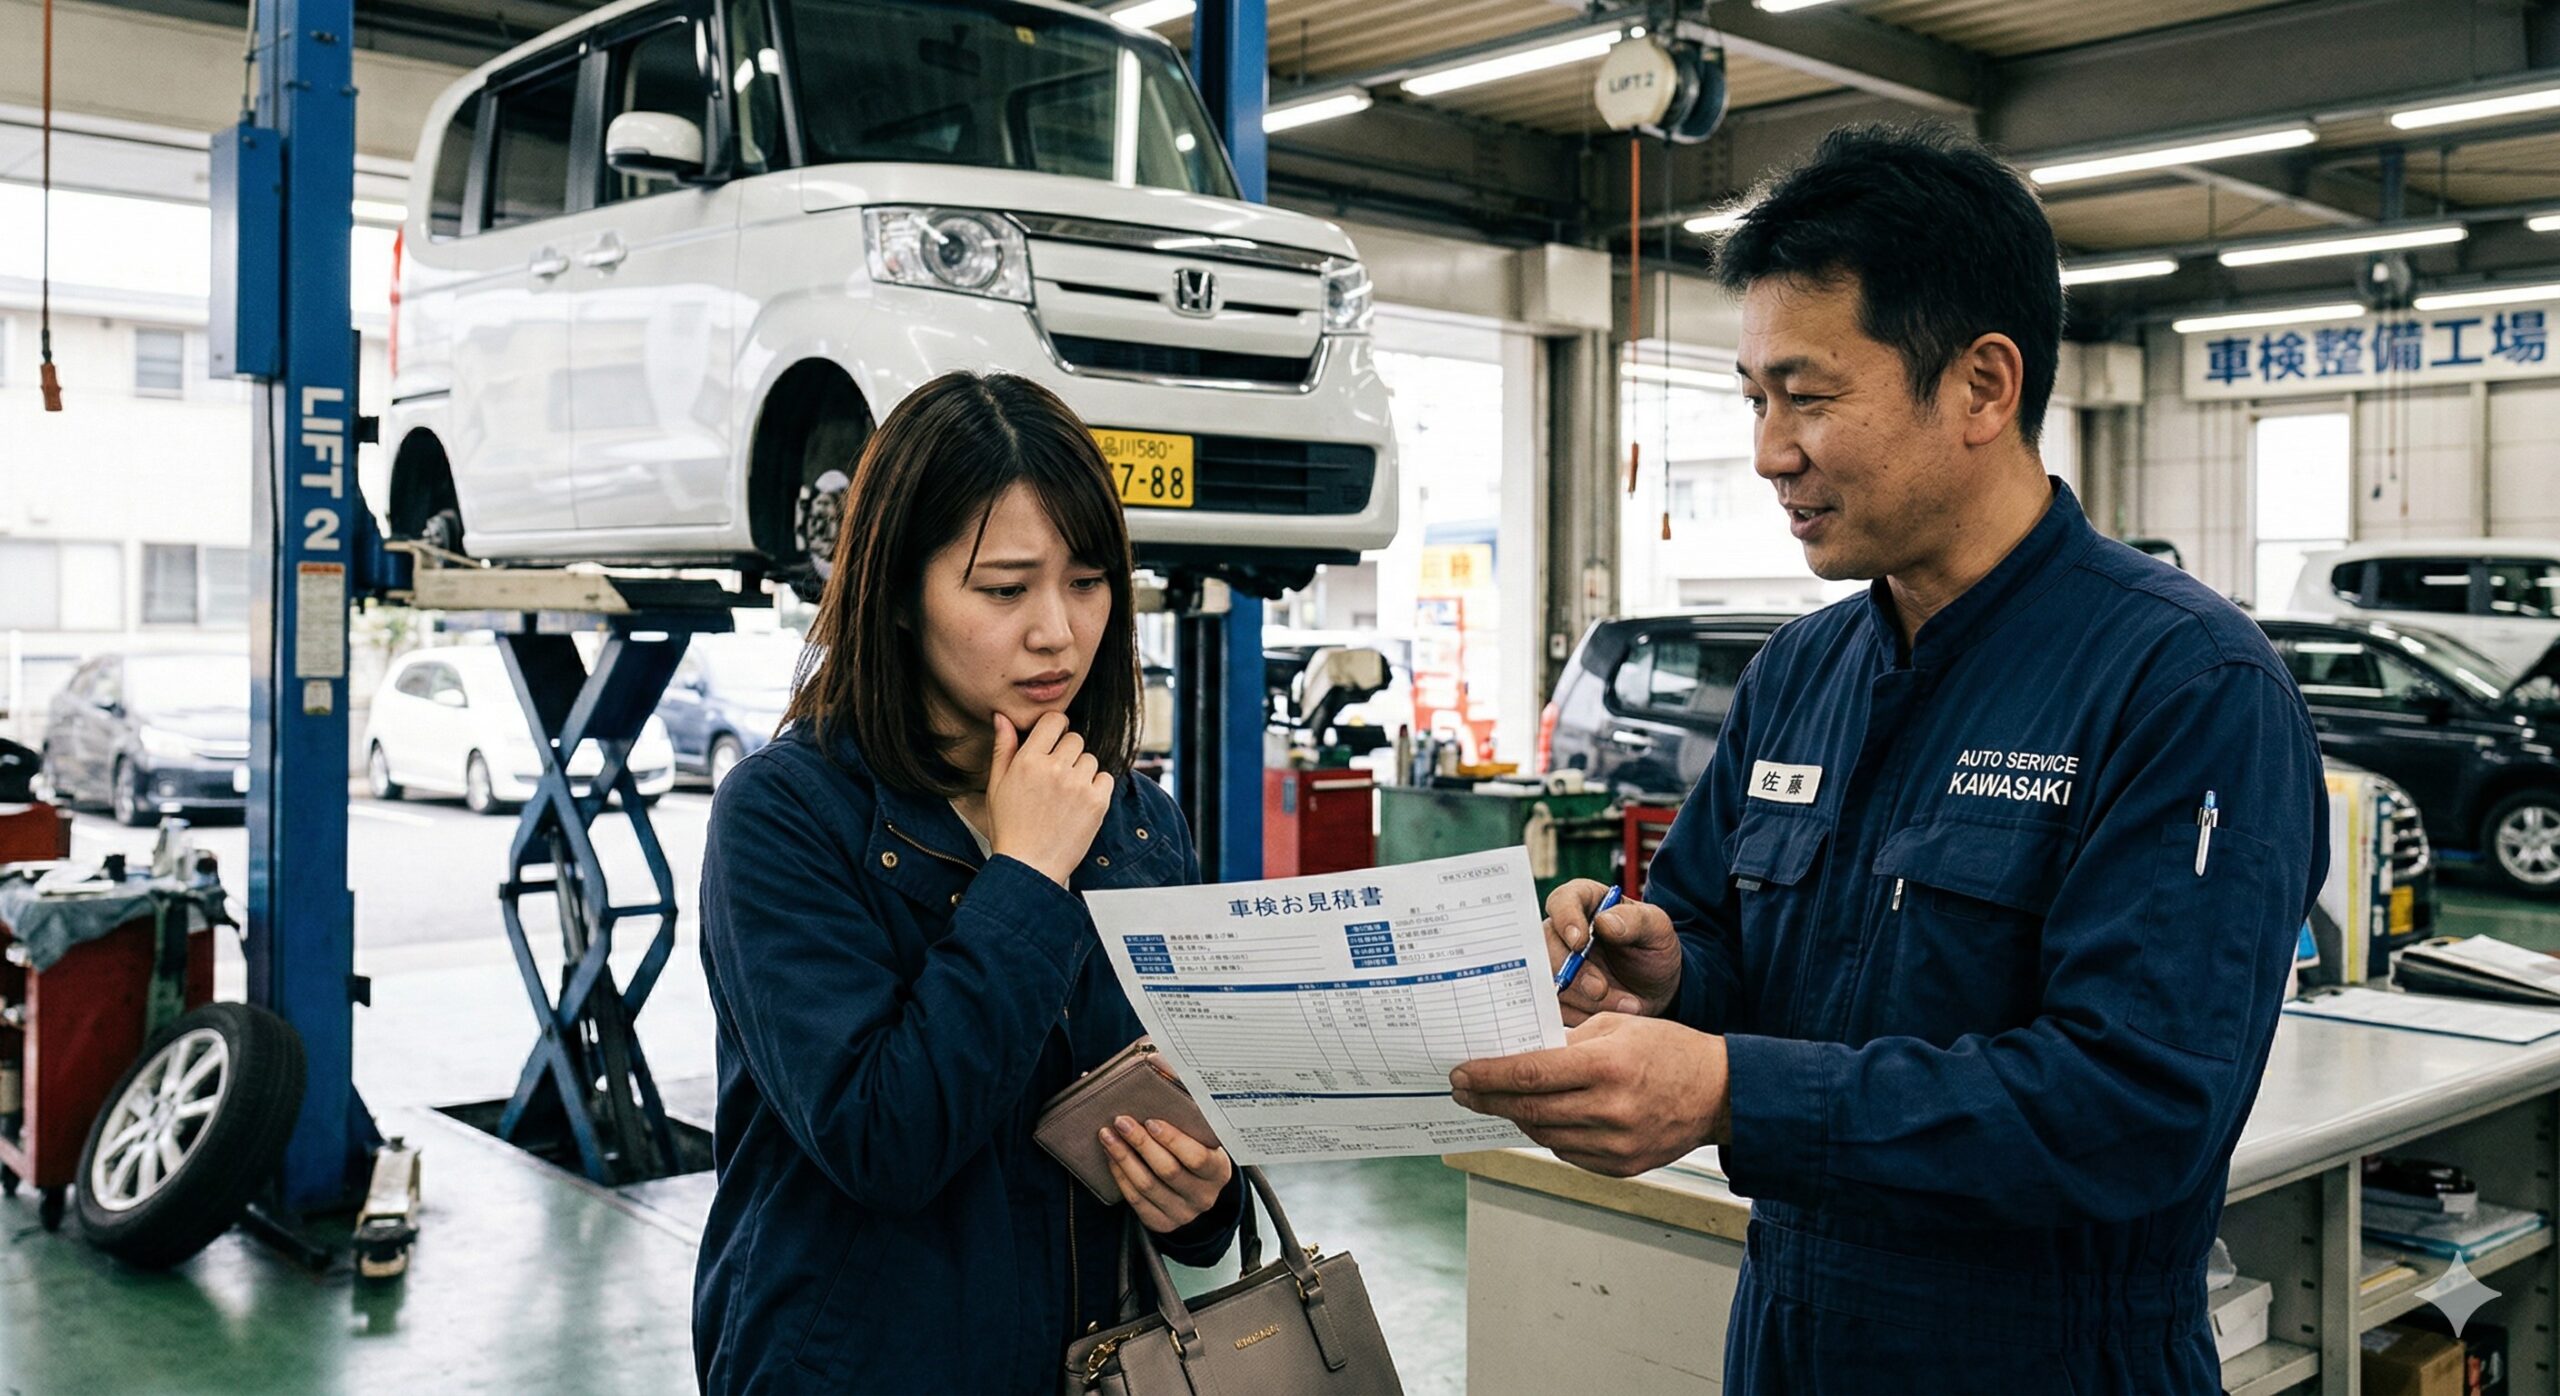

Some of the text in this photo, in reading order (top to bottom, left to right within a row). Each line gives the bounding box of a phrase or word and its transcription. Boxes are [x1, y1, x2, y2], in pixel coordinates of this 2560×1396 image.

[1608, 71, 1655, 94] LIFT 2
[2205, 310, 2549, 386] 車検整備工場
[301, 386, 344, 499] LIFT
[1109, 463, 1184, 499] 7-88
[303, 508, 341, 550] 2
[1956, 749, 2079, 774] AUTO SERVICE
[1761, 770, 1804, 796] 佐藤
[1947, 771, 2072, 805] KAWASAKI
[1228, 885, 1383, 919] 車検お見積書
